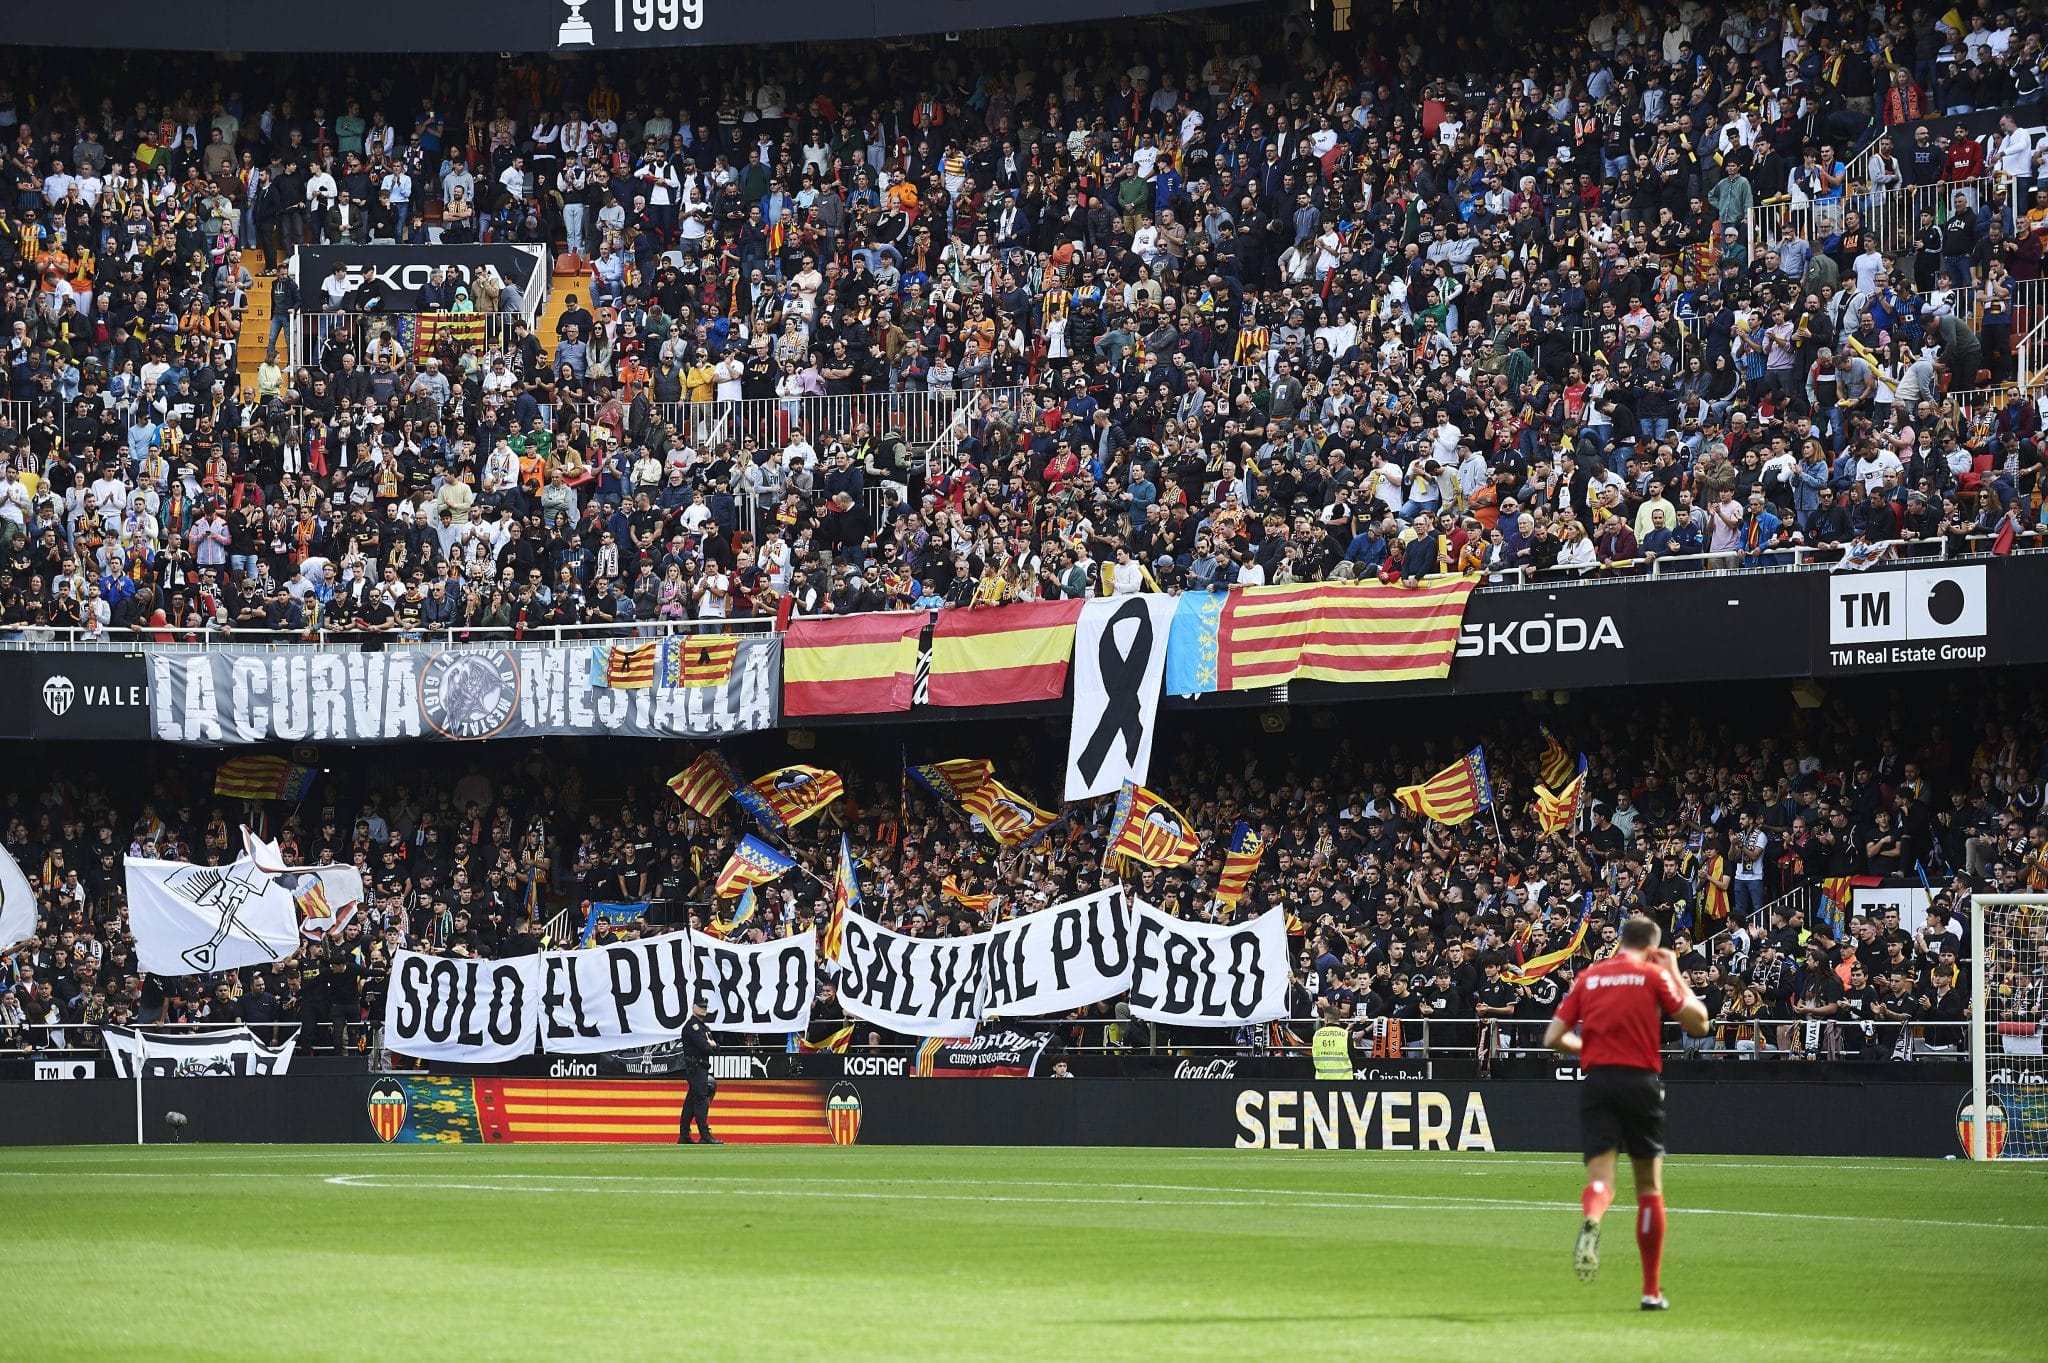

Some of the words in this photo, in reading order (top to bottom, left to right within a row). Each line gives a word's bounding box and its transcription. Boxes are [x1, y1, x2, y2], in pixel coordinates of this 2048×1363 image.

[614, 0, 705, 32] 1999
[1840, 591, 1891, 628] TM
[1830, 650, 1853, 666] TM
[1857, 647, 1887, 665] Real
[1892, 647, 1936, 663] Estate
[1940, 644, 1987, 663] Group
[84, 685, 150, 707] VALE
[154, 655, 222, 742] LA
[232, 651, 421, 742] CURVA
[841, 921, 985, 1021] SALVA
[987, 922, 1038, 1007] AL
[1051, 892, 1265, 1018] PUEBLO
[396, 956, 525, 1046] SOLO
[541, 956, 600, 1040] EL
[608, 939, 808, 1035] PUEBLO
[1322, 1039, 1335, 1047] 611
[39, 1067, 59, 1080] TM
[550, 1059, 597, 1078] divina
[1234, 1089, 1496, 1153] SENYERA
